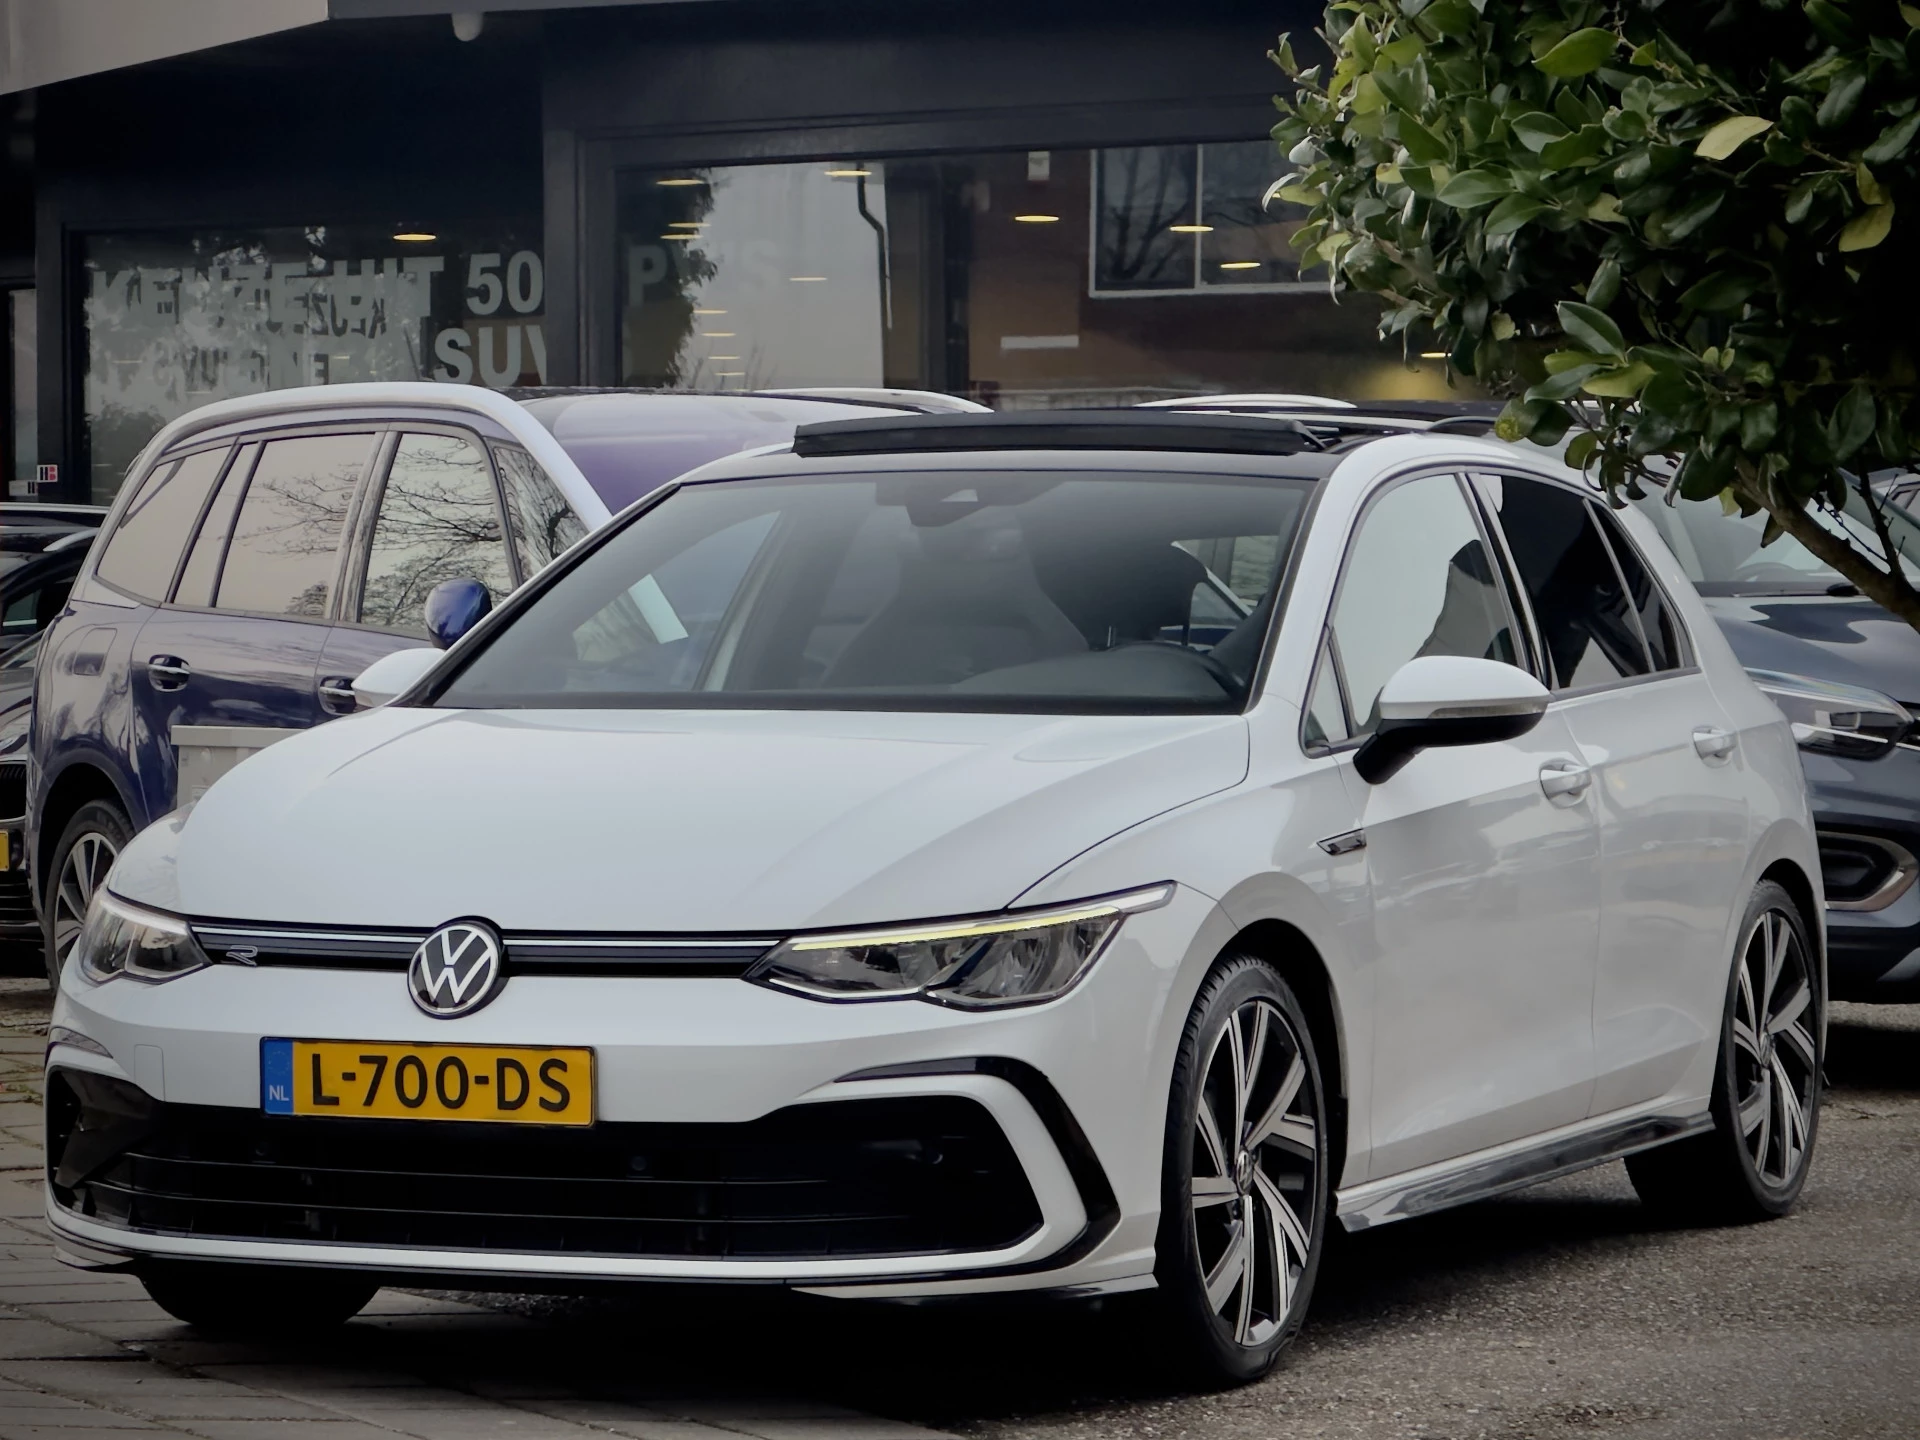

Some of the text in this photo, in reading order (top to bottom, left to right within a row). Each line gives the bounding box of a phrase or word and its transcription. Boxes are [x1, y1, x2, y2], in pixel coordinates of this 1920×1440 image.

[466, 250, 544, 316] 50
[267, 1084, 290, 1102] NL
[311, 1053, 571, 1113] L-700-DS
